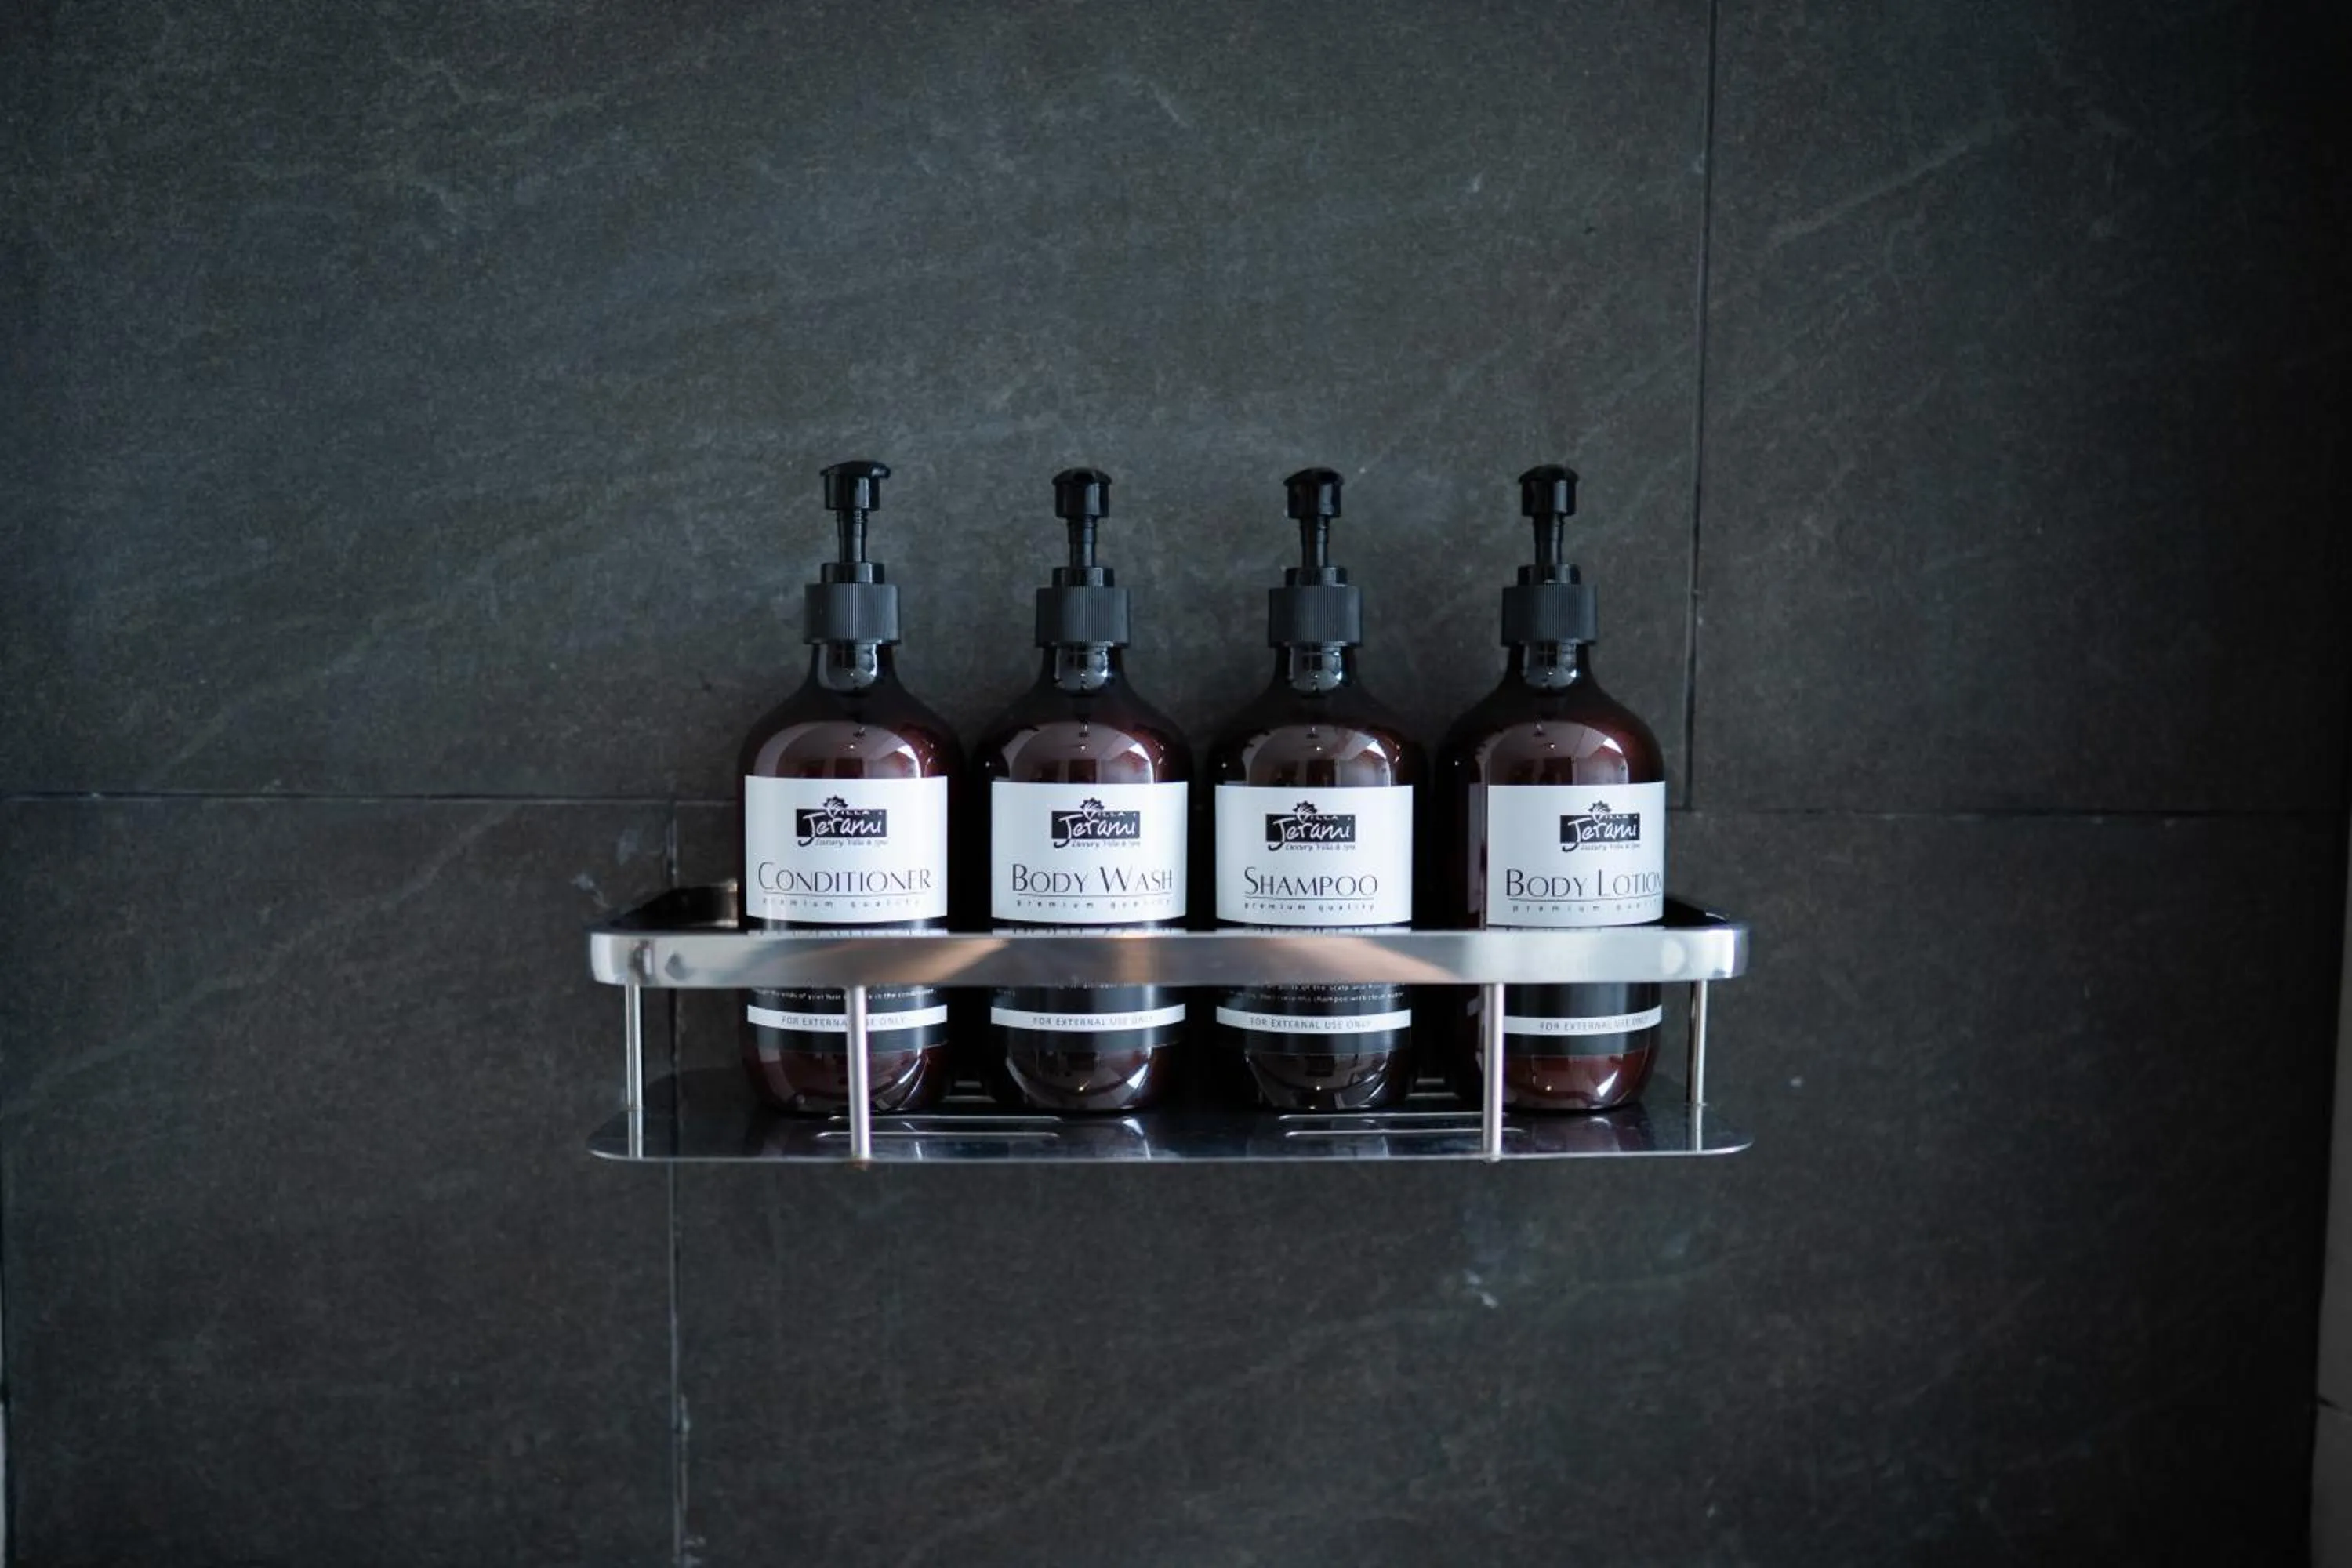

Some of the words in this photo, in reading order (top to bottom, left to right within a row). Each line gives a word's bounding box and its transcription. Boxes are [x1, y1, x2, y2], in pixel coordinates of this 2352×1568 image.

[798, 811, 883, 847] Jerami
[1053, 813, 1136, 848] Jerami
[1268, 817, 1351, 851] Jerami
[1562, 817, 1636, 852] Jerami
[758, 862, 931, 892] CONDITIONER
[1012, 863, 1088, 893] BODY
[1099, 866, 1172, 893] WASH
[1244, 866, 1377, 896] SHAMPOO
[1506, 868, 1587, 897] BODY
[802, 1018, 848, 1028] EXTERNA
